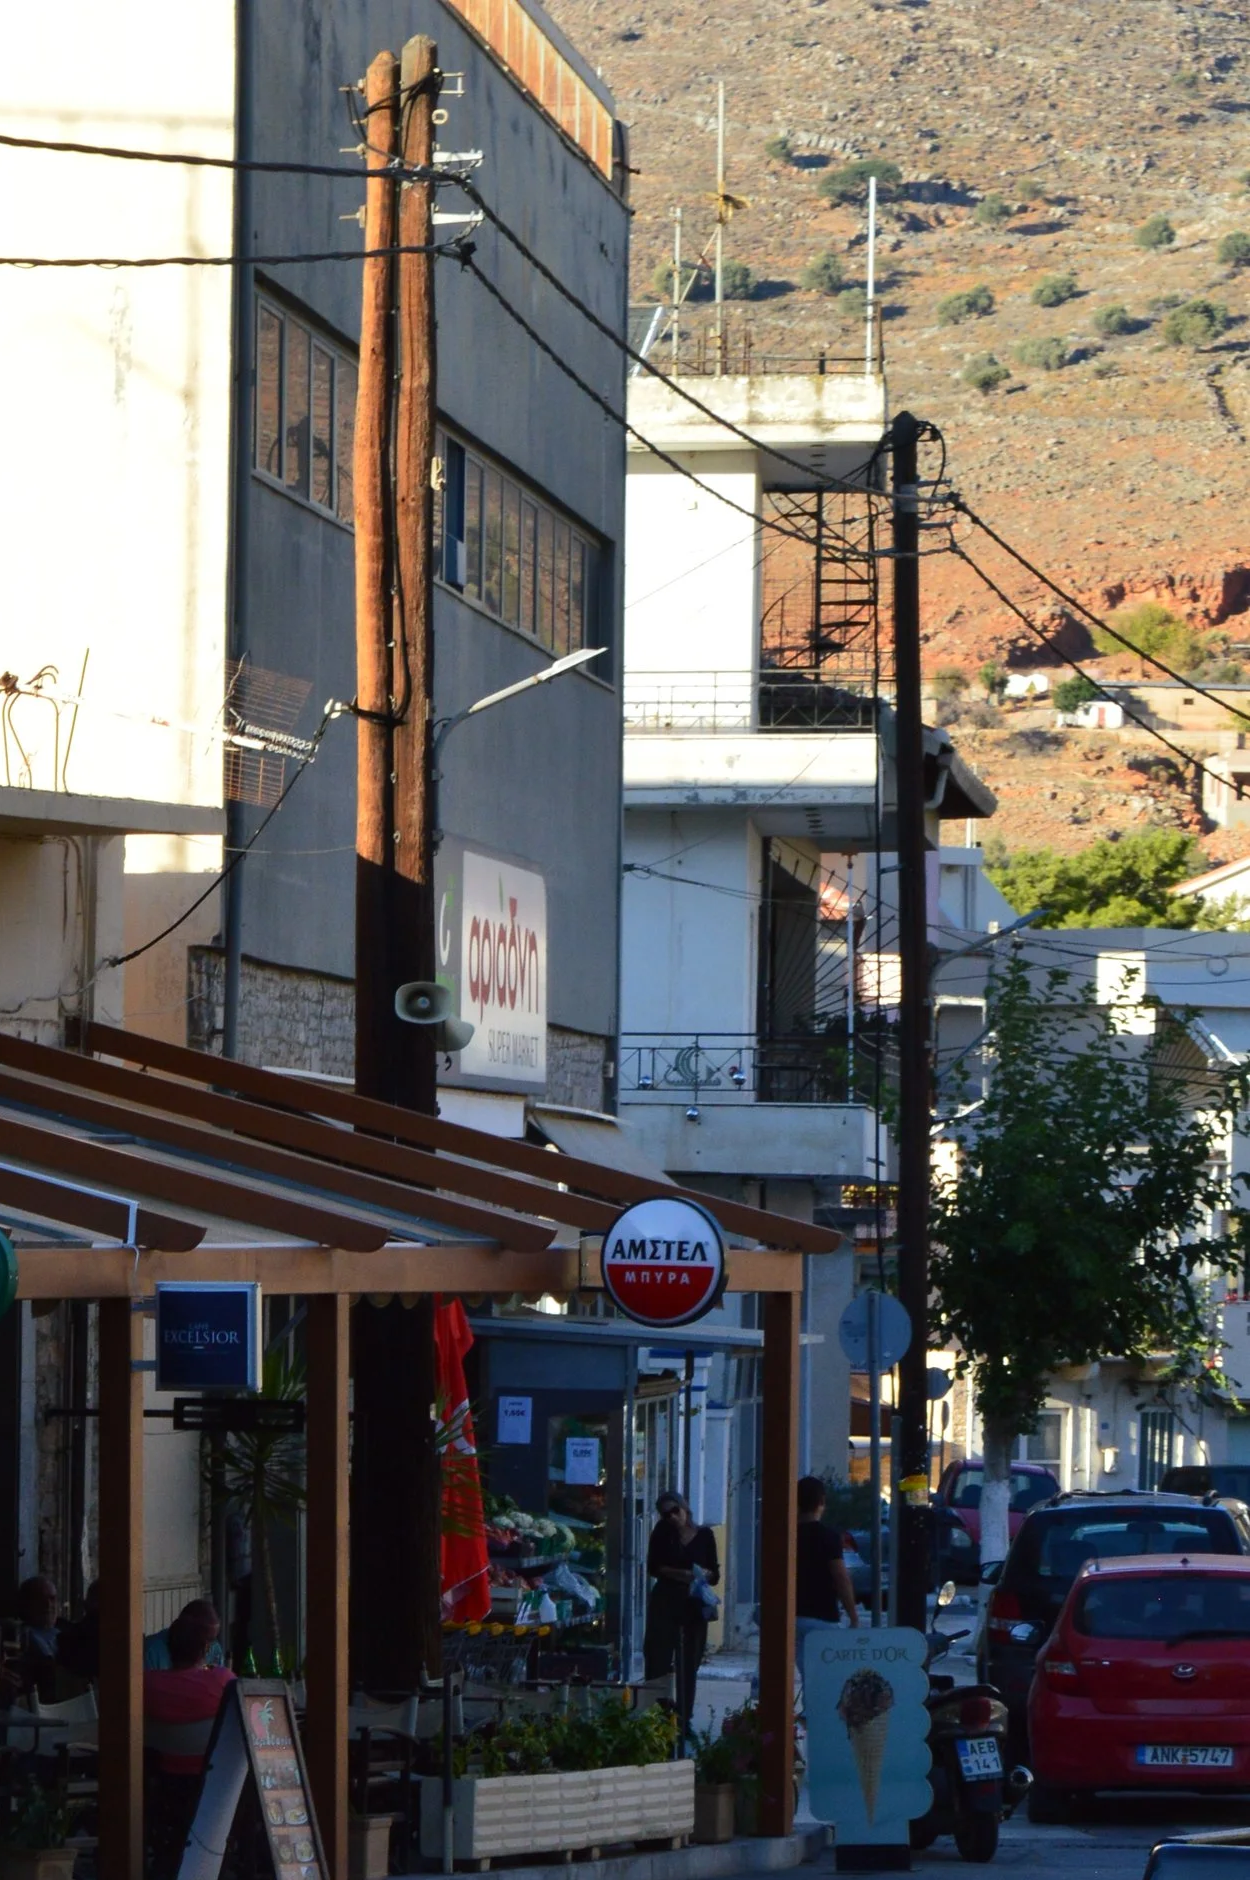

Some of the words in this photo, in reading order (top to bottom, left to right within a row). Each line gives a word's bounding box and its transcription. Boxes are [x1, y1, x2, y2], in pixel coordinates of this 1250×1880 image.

[487, 1028, 511, 1064] SUPER
[512, 1034, 539, 1069] MARKET
[611, 1239, 707, 1262] ΑΜΣΤΕΛ
[624, 1271, 691, 1285] ΜΠΥΡΑ
[163, 1329, 240, 1345] EXCELSIOR
[820, 1647, 867, 1664] CARTE
[973, 1756, 1000, 1772] 141
